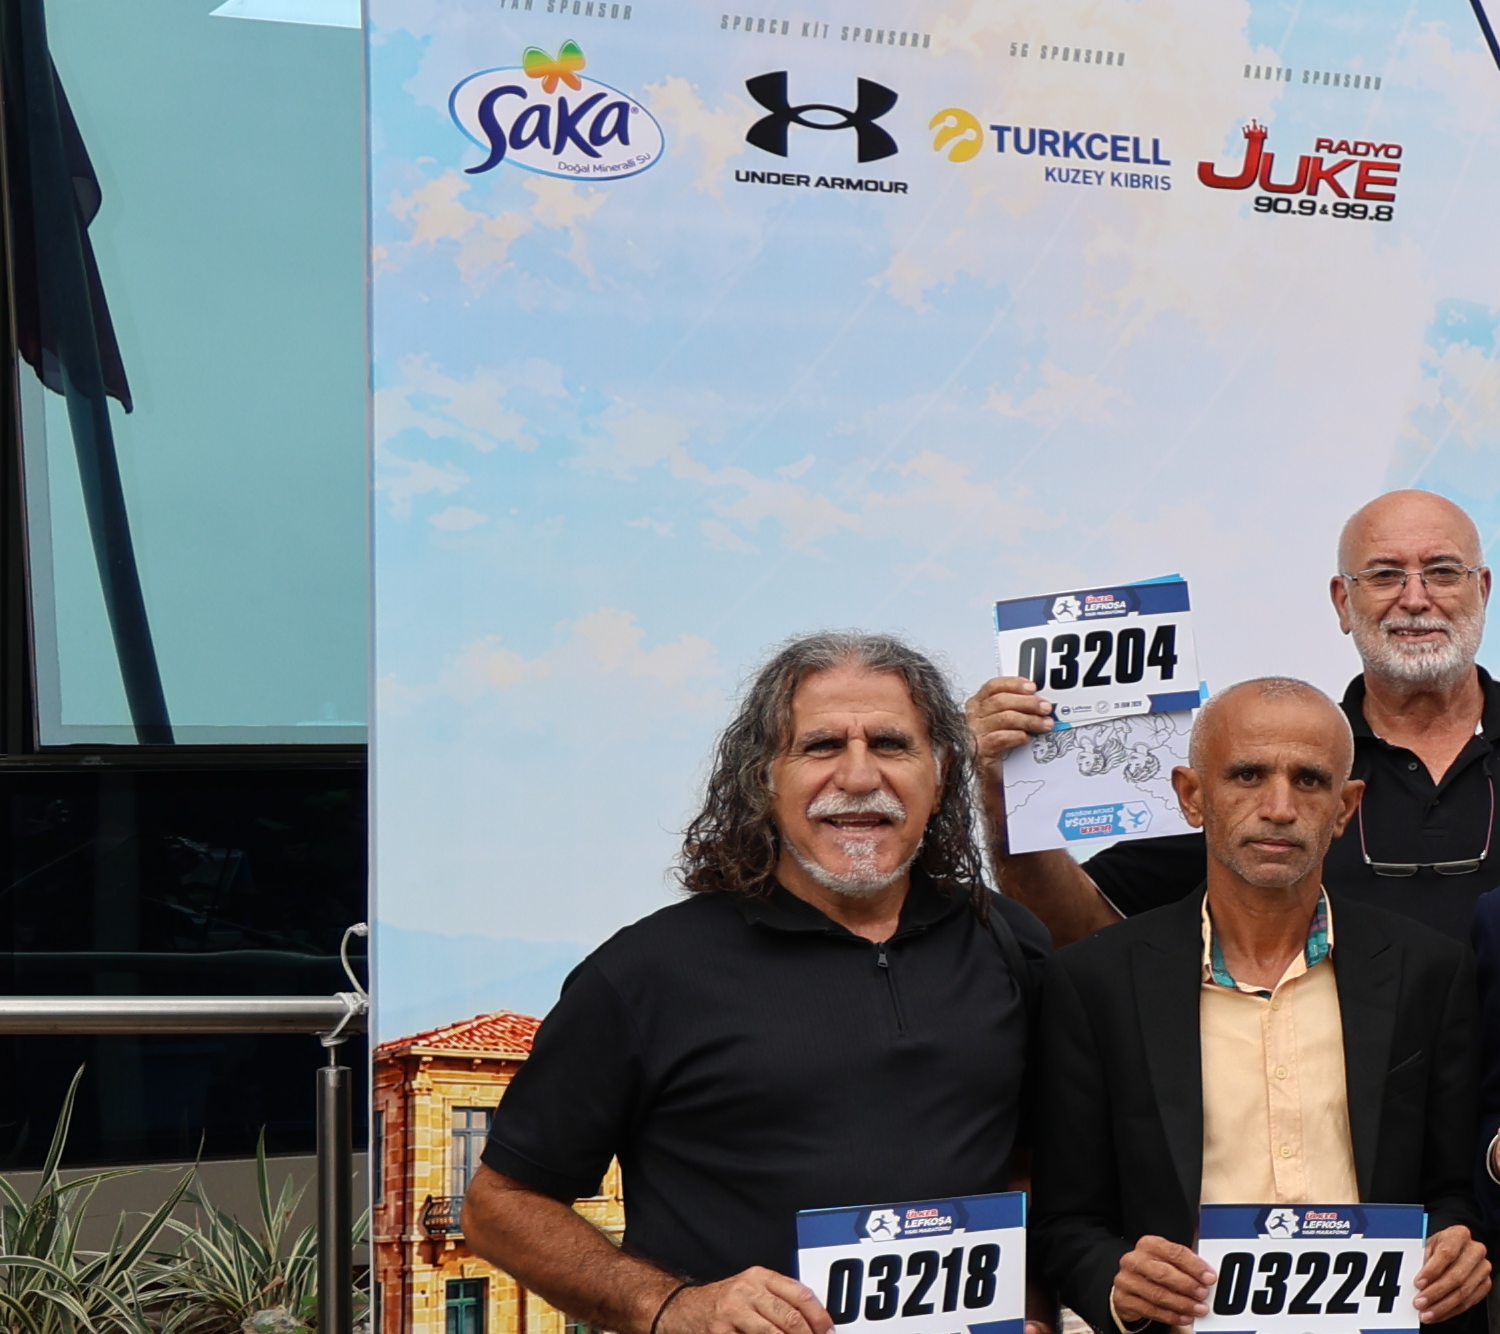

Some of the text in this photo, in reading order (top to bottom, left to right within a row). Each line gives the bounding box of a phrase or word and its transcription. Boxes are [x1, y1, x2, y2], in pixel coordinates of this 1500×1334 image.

[721, 14, 931, 50] SPORCU KİT SPONSORU
[1010, 42, 1126, 67] 5G SPONSORU
[1243, 64, 1383, 91] RADYO SPONSORU
[989, 123, 1172, 166] TURKCELL
[1315, 137, 1403, 159] RADYO
[1197, 121, 1402, 202] JUKE
[735, 169, 909, 195] UNDER ARMOUR
[1045, 166, 1172, 192] KUZEY KIBRIS
[1253, 195, 1316, 217] 90.9
[1331, 201, 1394, 223] 99.8
[1018, 624, 1178, 693] 03204
[904, 1216, 953, 1229] LEFKOŞA
[1302, 1220, 1351, 1231] LEFKOŞA
[826, 1243, 1001, 1325] 03218
[1213, 1251, 1404, 1316] 03224
